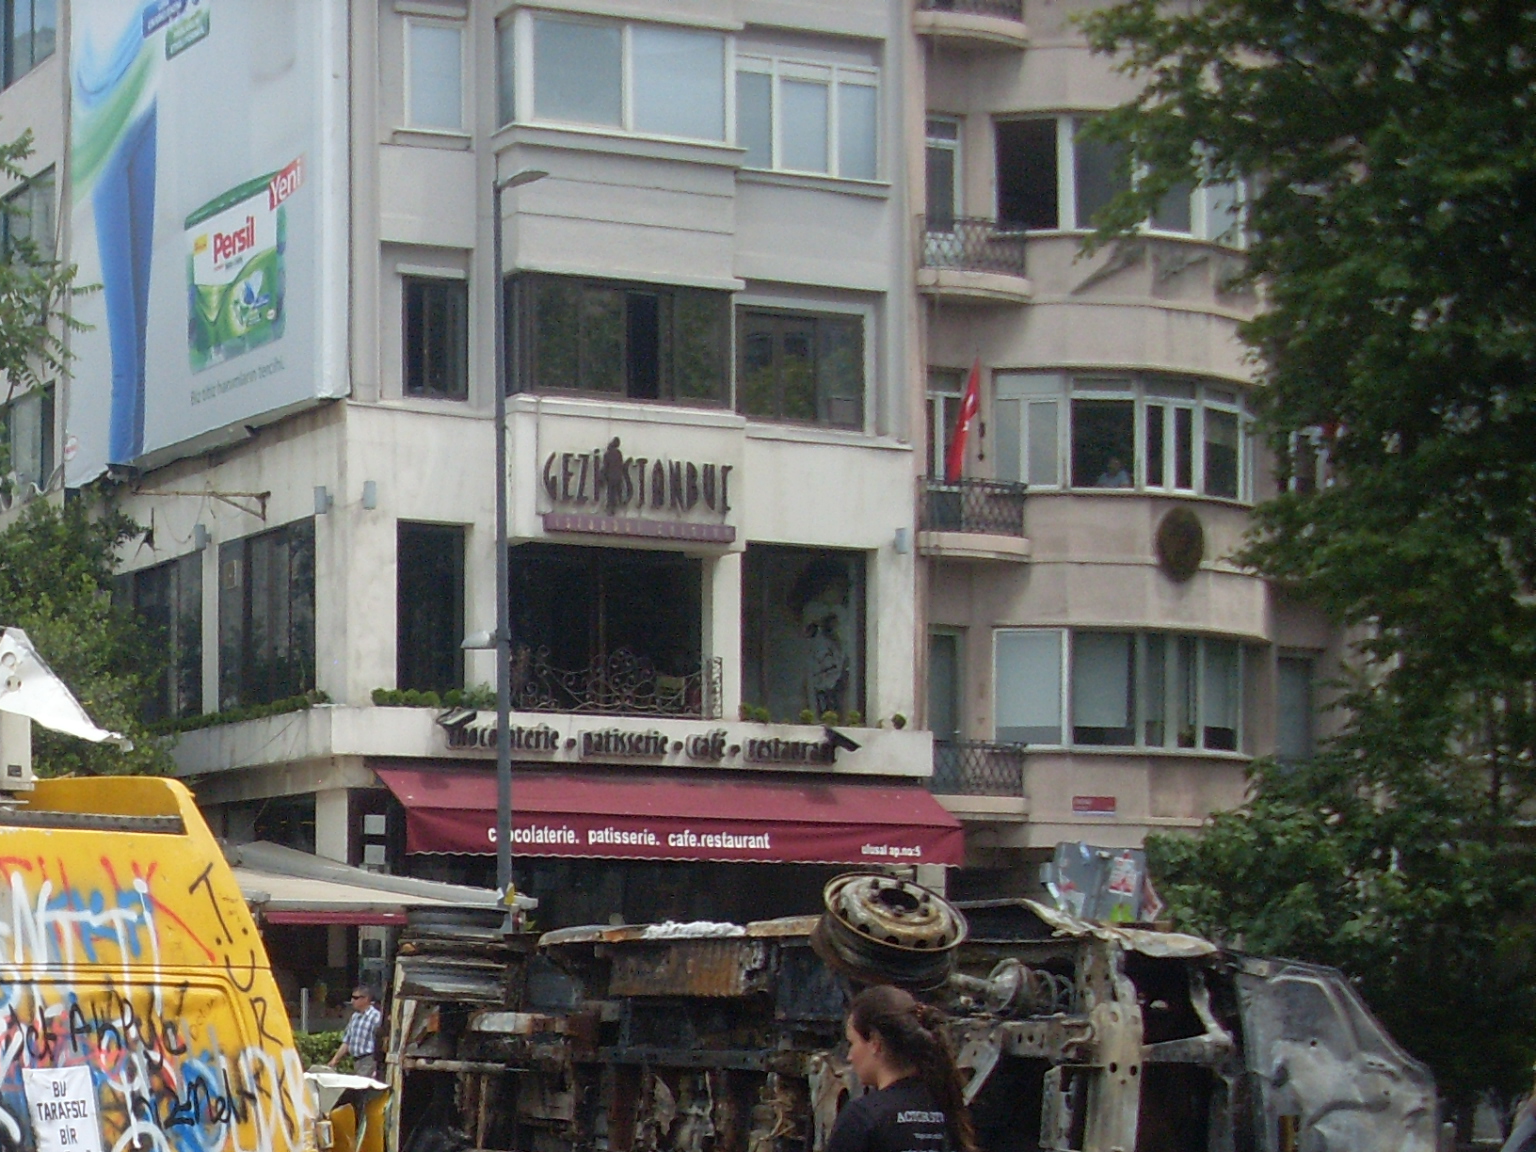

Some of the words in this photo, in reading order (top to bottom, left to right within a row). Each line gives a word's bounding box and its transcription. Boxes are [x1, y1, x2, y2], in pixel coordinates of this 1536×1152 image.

[270, 157, 302, 203] Yeni
[213, 215, 255, 265] Persil
[581, 728, 669, 757] patisserie
[52, 1081, 67, 1098] BU
[36, 1099, 89, 1121] TARAFSIZ
[59, 1125, 79, 1146] BİR
